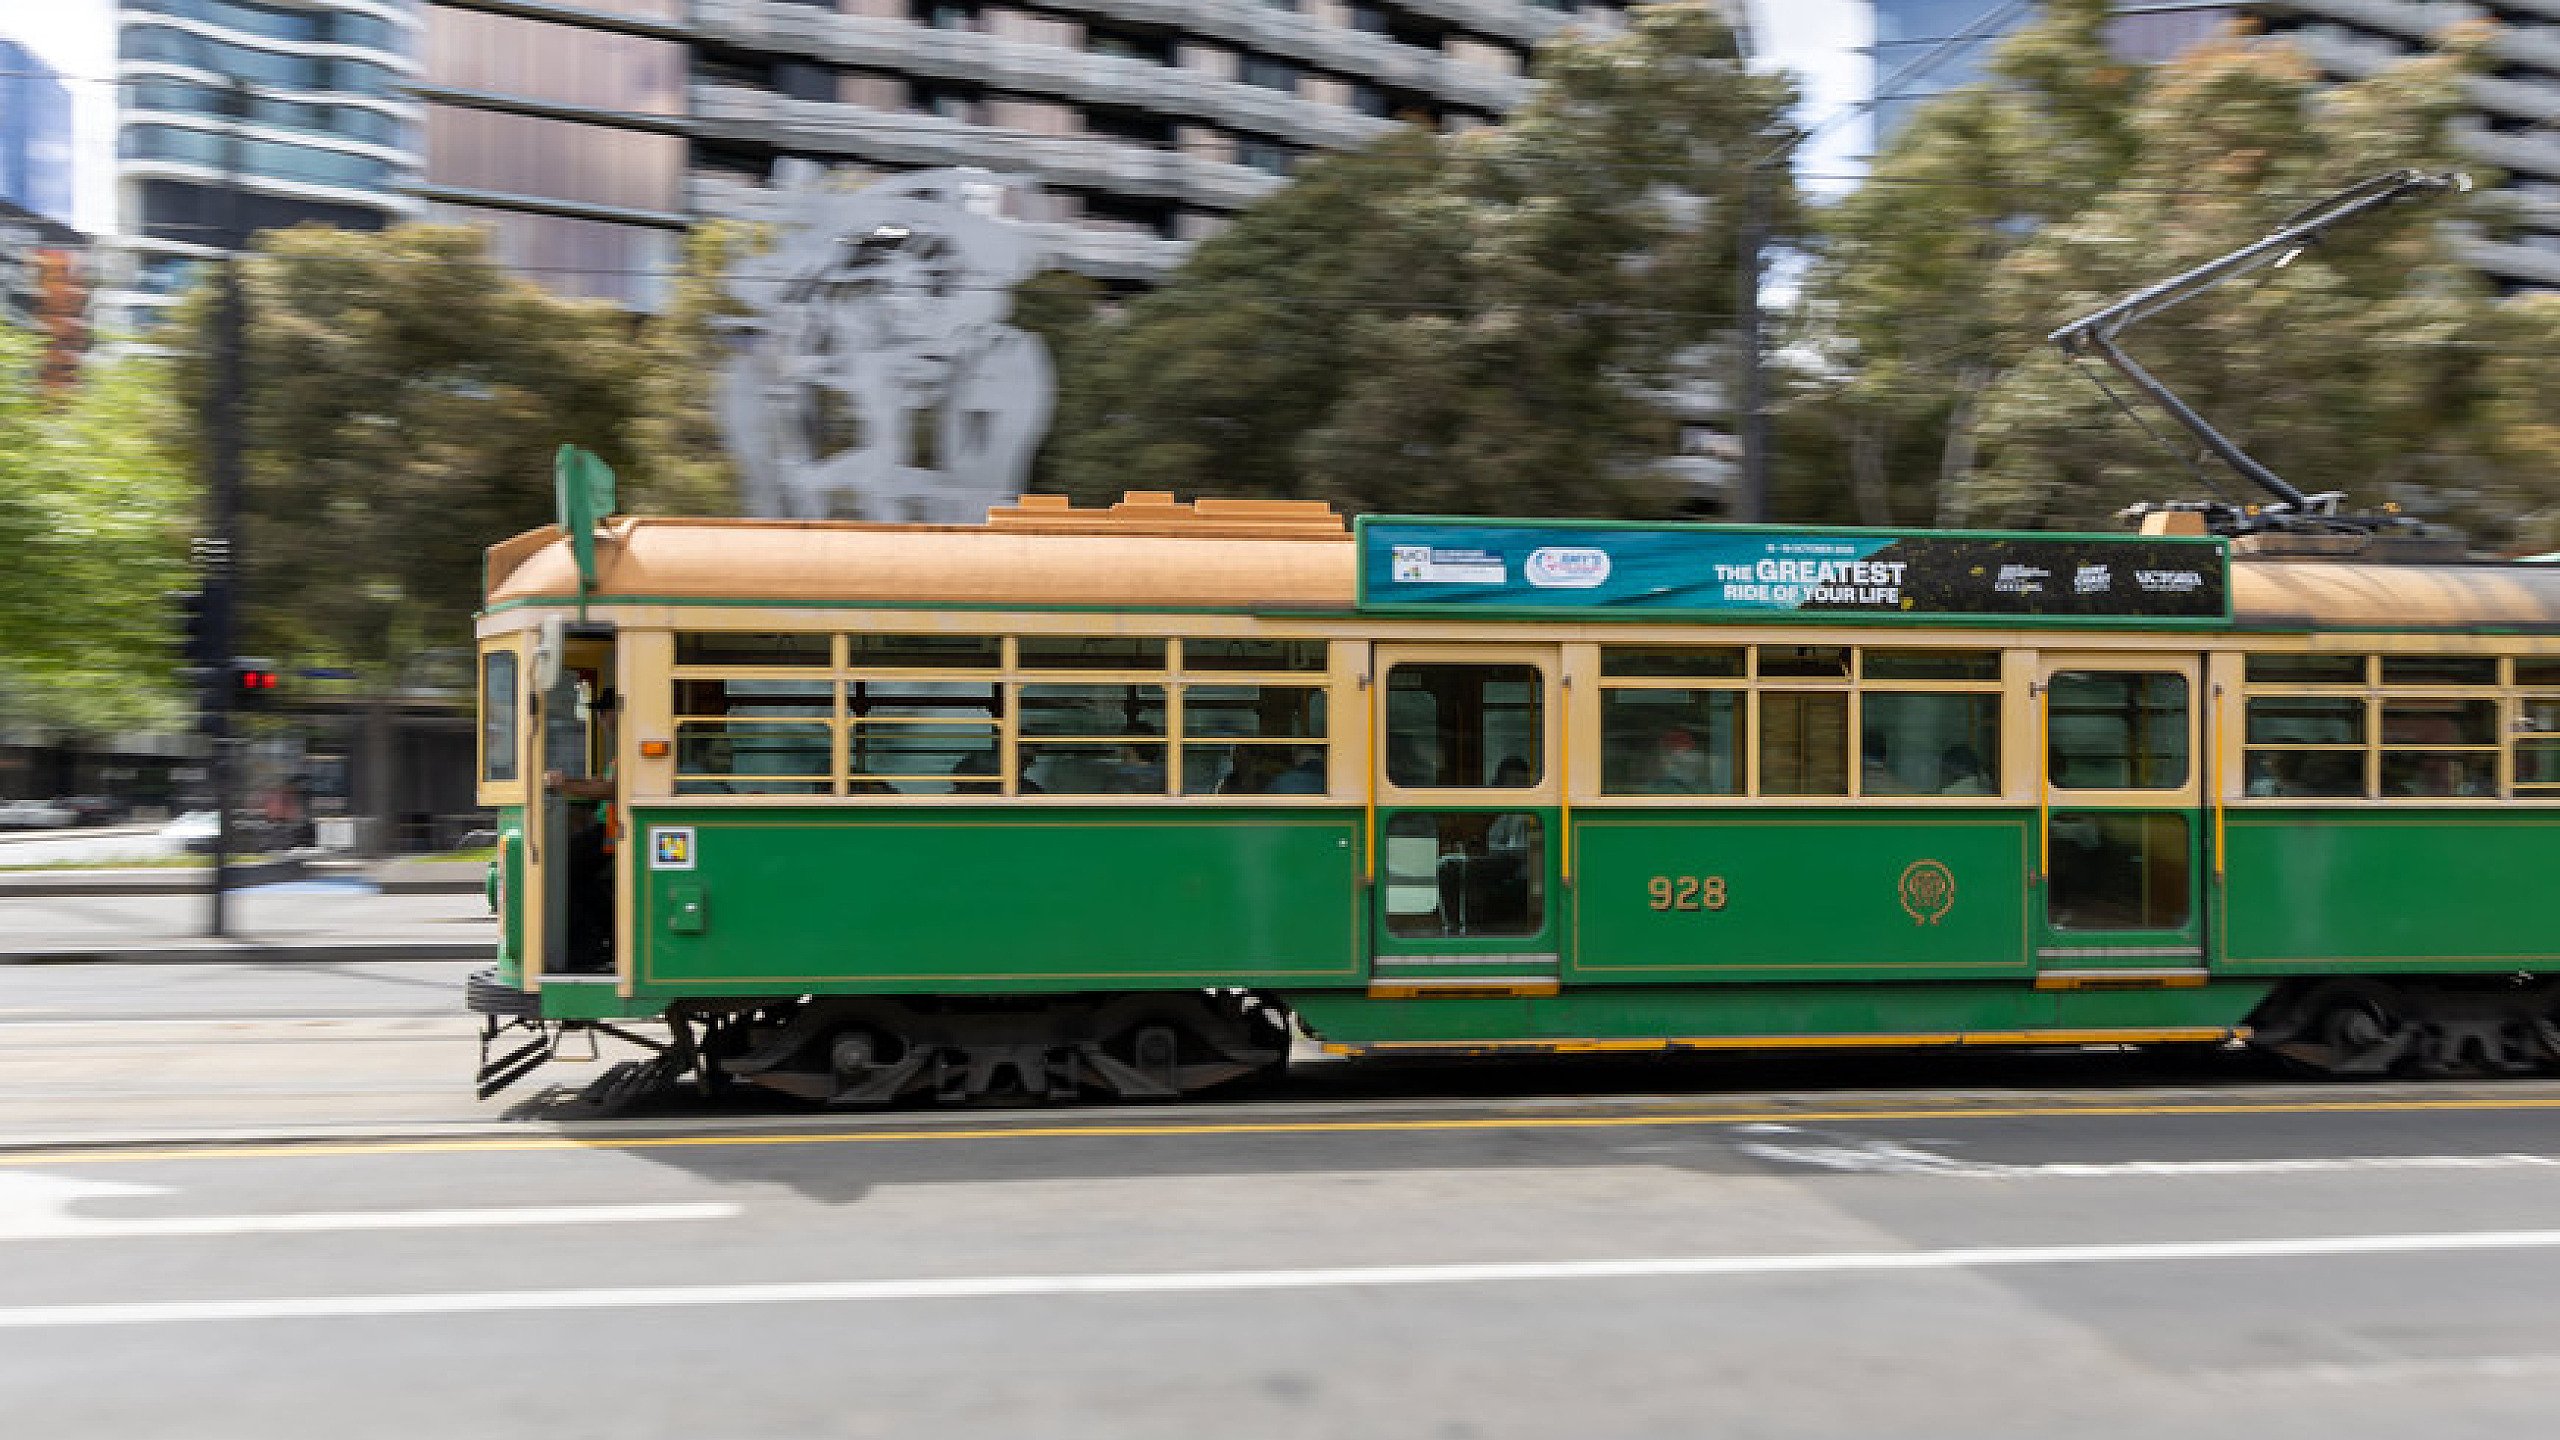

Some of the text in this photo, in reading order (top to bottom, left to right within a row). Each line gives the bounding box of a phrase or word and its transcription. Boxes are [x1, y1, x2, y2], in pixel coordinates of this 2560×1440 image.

[1714, 558, 1907, 585] THE GREATEST
[1723, 585, 1899, 603] RIDE OF YOUR LIFE
[1647, 875, 1728, 911] 928
